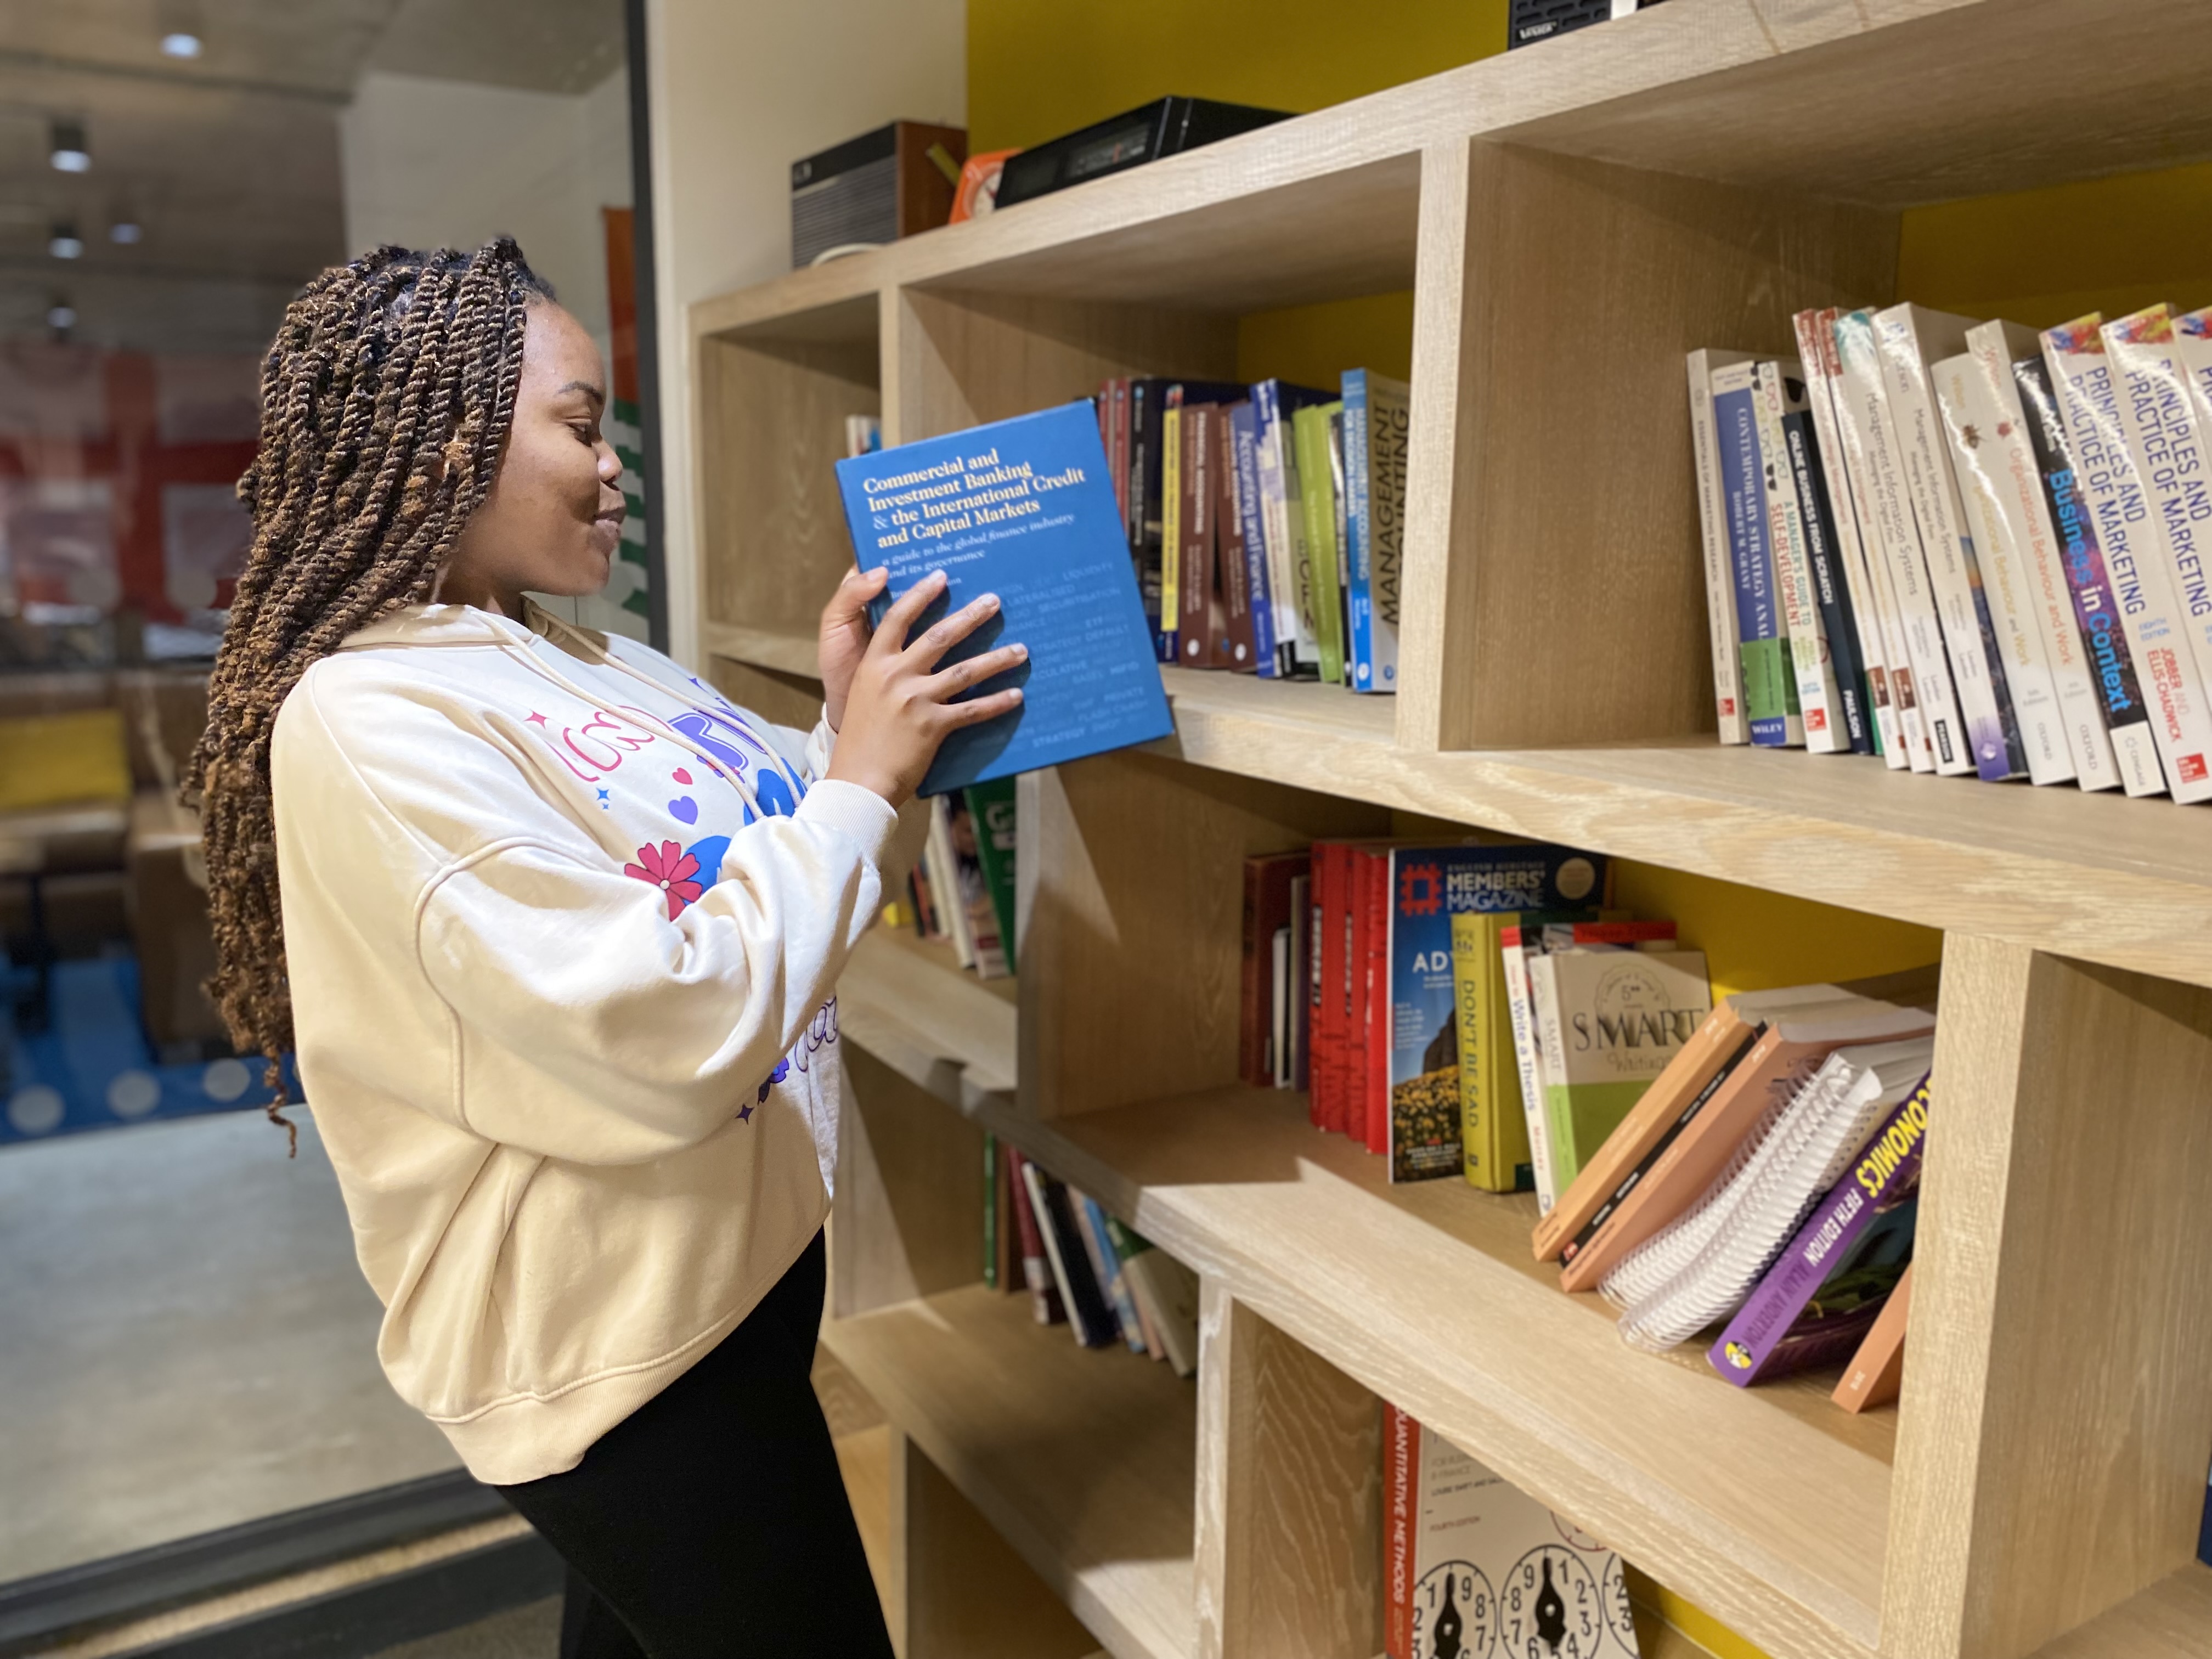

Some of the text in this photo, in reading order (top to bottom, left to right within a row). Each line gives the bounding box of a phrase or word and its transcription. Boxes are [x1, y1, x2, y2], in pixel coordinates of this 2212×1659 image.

[863, 448, 1000, 494] Commercial and
[867, 461, 1034, 512] Investment Banking
[1238, 430, 1257, 517] Accounting
[1914, 408, 1956, 574] Management Information Systems
[2090, 471, 2113, 495] OF
[873, 467, 1086, 530] & the International Credit
[1375, 402, 1399, 625] MANAGEMENT
[1866, 392, 1889, 470] Management
[1883, 470, 1906, 543] Information
[1898, 544, 1917, 596] Systems
[2117, 483, 2146, 522] AND
[2125, 371, 2211, 617] PRACTICE OF MARKETING
[2181, 481, 2211, 522] AND
[878, 500, 1041, 549] and Capital Markets
[1245, 516, 1261, 545] and
[1737, 408, 1768, 639] CONTEMPORARY STRATEGY ANAL
[1789, 430, 1833, 604] ONLINE BUSINESS FROM SCRATCH
[891, 549, 921, 566] guide
[923, 548, 934, 557] to
[936, 541, 952, 554] the
[955, 533, 987, 550] global
[987, 524, 1028, 543] finance
[1030, 514, 1075, 532] industry
[1733, 490, 1745, 534] ROBERT
[1739, 551, 1751, 590] GRANT
[1786, 510, 1804, 573] MANAGER'S
[2010, 447, 2074, 665] Organizational Behaviour and Work
[2097, 499, 2146, 616] MARKETING
[909, 563, 923, 574] its
[924, 549, 985, 572] governance
[1248, 545, 1263, 601] Finance
[1771, 503, 1801, 627] SELF-DEVELOPMENT
[1972, 485, 2001, 554] ganizational
[1995, 556, 2017, 615] Behaviour
[2015, 633, 2030, 666] Work
[1003, 584, 1076, 608] LATERALISED
[1796, 575, 1809, 609] GUIDE
[2049, 468, 2132, 713] Business in Context
[1801, 610, 1811, 627] TO
[2138, 617, 2167, 631] EIGHTH
[2140, 627, 2170, 641] EDITION
[2147, 648, 2182, 742] ELLIS-CHADWICK
[2160, 647, 2190, 715] JOBBER AND
[1752, 723, 1783, 735] WILEY
[1843, 689, 1862, 738] PAULSON
[1936, 723, 1953, 761] PEARSON
[2038, 722, 2052, 760] OXFORD
[2080, 724, 2098, 770] OXFORD
[1446, 870, 1545, 893] MEMBERS'
[1447, 889, 1544, 911] MAGAZINE
[1412, 951, 1454, 973] AD
[1514, 998, 1528, 1042] Write
[1572, 1008, 1704, 1052] SMART
[1465, 1054, 1479, 1079] BE
[1519, 1046, 1528, 1056] a
[1522, 1060, 1536, 1111] Thesis
[1467, 1087, 1479, 1128] SAD
[1742, 1077, 1931, 1349] CONOMICS FIFTH EDITION ALAIN ANDERTON
[1393, 1520, 1407, 1605] METHODS
[1523, 1564, 1534, 1589] 9
[1558, 1559, 1568, 1585] 1
[1427, 1582, 1436, 1609] 1
[1462, 1576, 1472, 1602] 9
[1475, 1593, 1485, 1619] 8
[1510, 1586, 1521, 1612] 8
[1576, 1578, 1588, 1604] 2
[1613, 1574, 1628, 1600] 2
[1475, 1625, 1486, 1651] 7
[1510, 1618, 1521, 1645] 7
[1579, 1611, 1592, 1637] 3
[1618, 1606, 1633, 1633] 3
[1527, 1636, 1540, 1659] 6
[1567, 1632, 1580, 1659] 4
